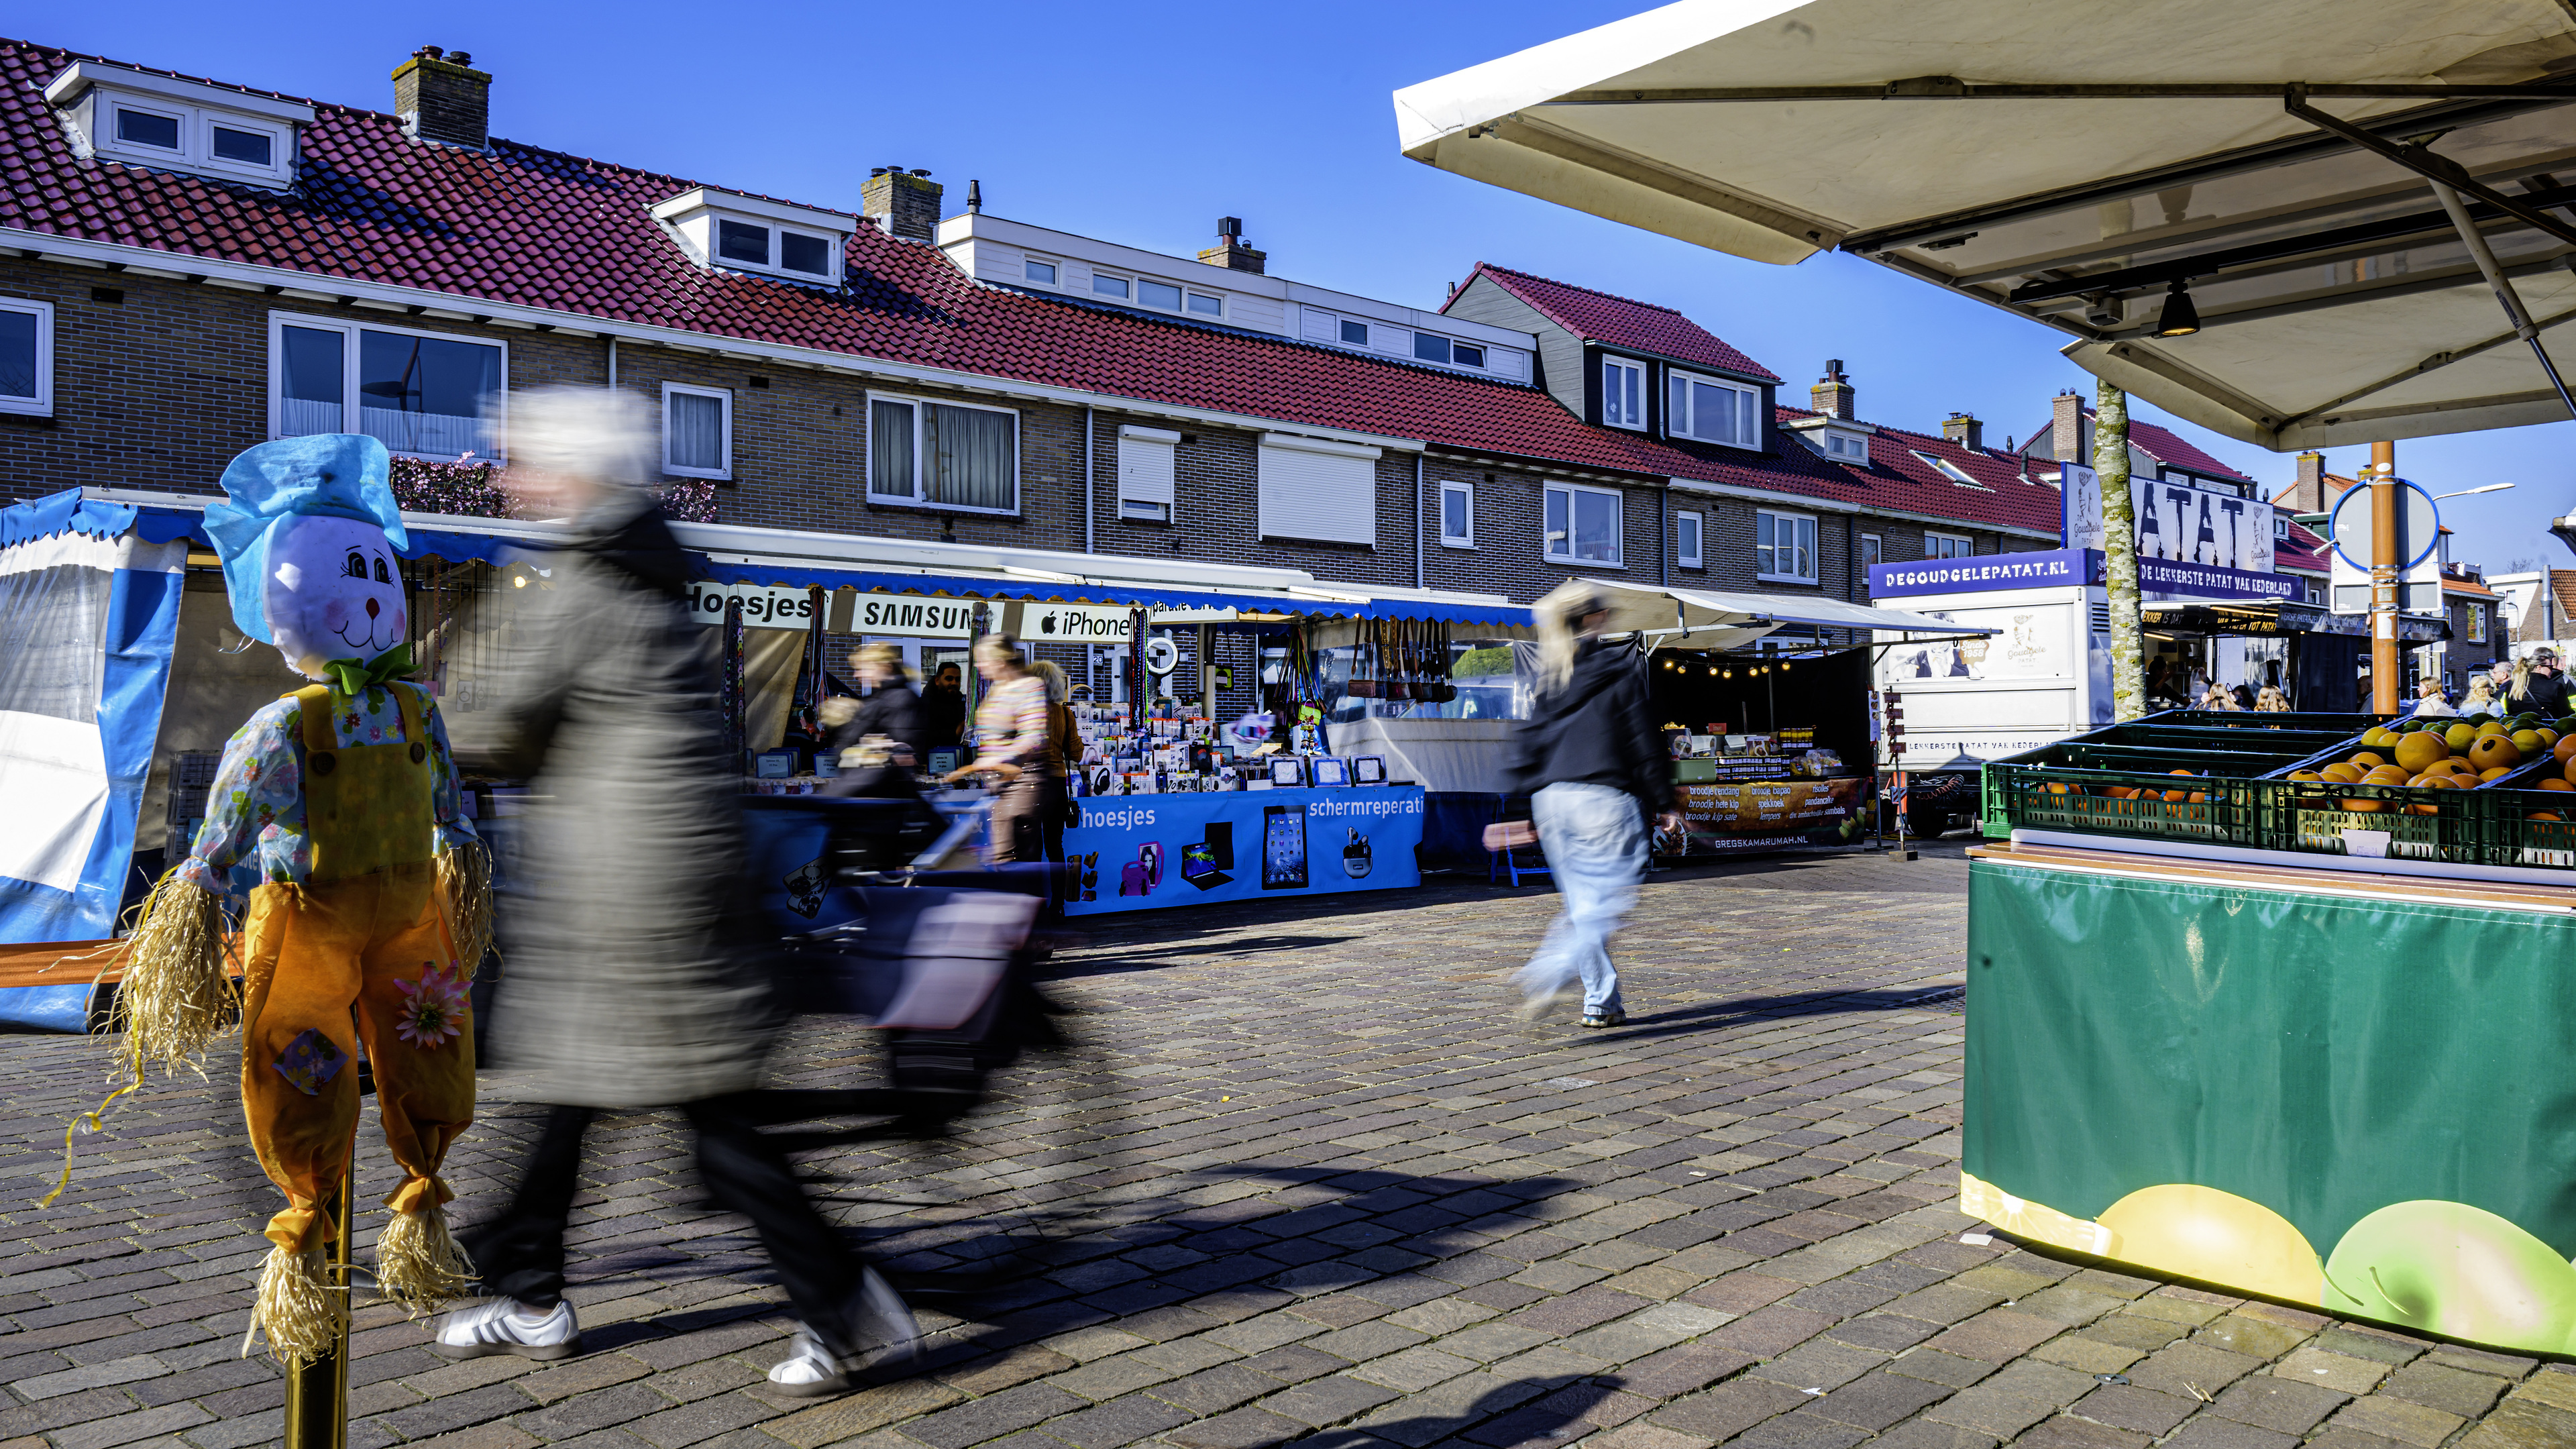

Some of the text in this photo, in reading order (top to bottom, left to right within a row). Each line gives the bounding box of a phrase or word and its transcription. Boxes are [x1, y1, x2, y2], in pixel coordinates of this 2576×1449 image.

[2136, 482, 2244, 568] ATAT
[1886, 561, 2069, 586] DEGOUDGELEPATAT.NL
[2141, 564, 2292, 596] DE LEKKERSTE PATAT VAN NEDERLAND
[864, 602, 971, 630] SAMSUN
[2141, 611, 2162, 623] EKKER
[1063, 611, 1130, 635] iPhone
[1961, 641, 1988, 651] Sinds
[1964, 649, 1984, 657] 1958
[1909, 742, 1956, 750] LEKKERSTE
[1689, 786, 1739, 797] broodje rendang
[1752, 786, 1791, 796] broodje bapao
[1812, 784, 1829, 793] risolles
[1688, 799, 1739, 810] broodje hete kip
[1758, 798, 1784, 809] spekkoek
[1759, 812, 1782, 821] lempers
[1824, 806, 1845, 816] sambals
[1082, 806, 1156, 830] hoesjes
[1685, 812, 1711, 821] broodje
[1711, 812, 1723, 822] kip
[1715, 836, 1809, 849] GREGSKAMARUMAH.NL
